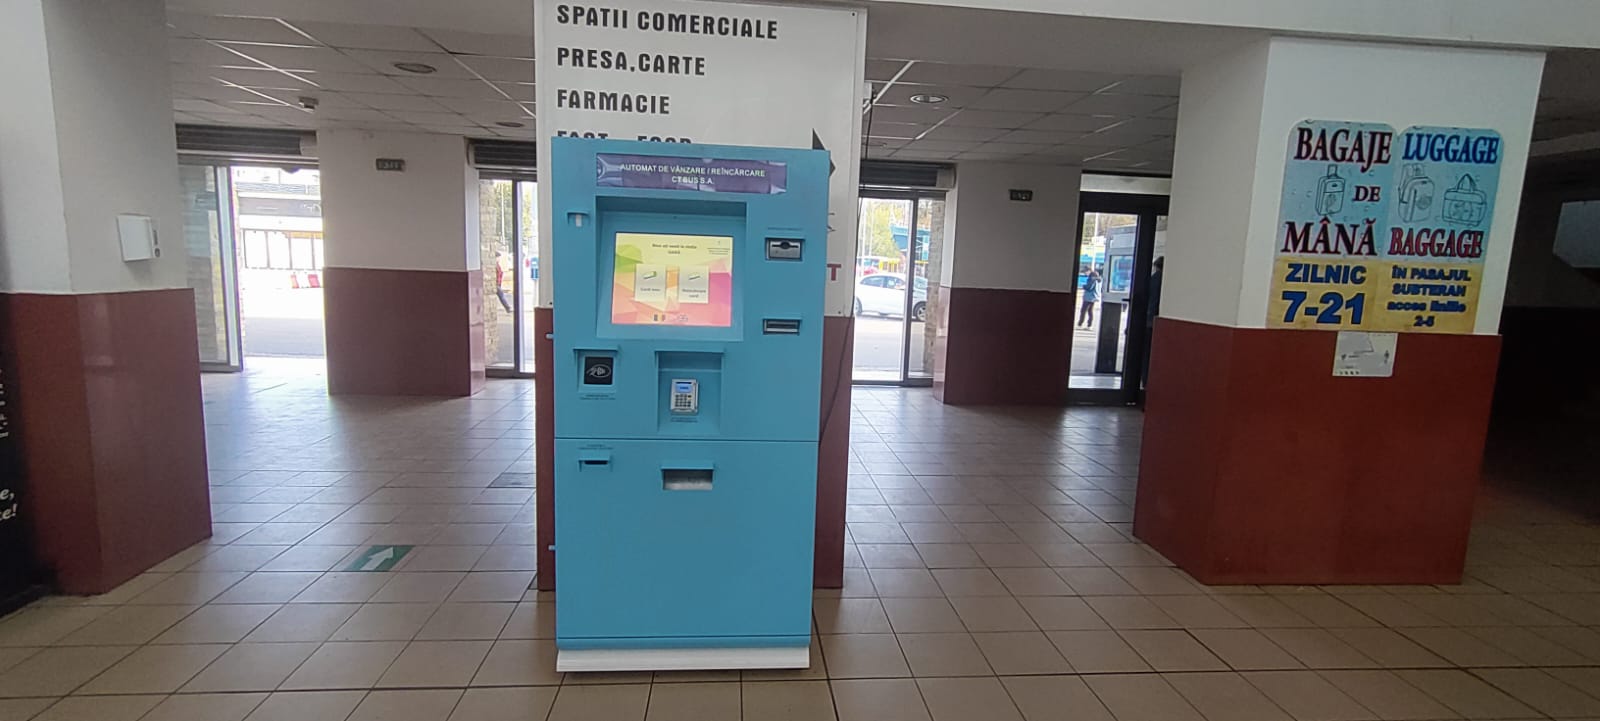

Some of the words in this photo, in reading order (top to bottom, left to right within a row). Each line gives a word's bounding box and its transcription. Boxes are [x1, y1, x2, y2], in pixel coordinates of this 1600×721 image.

[557, 5, 628, 29] SPATII
[637, 11, 778, 39] COMERCIALE
[557, 89, 670, 114] FARMACIE
[1294, 127, 1393, 173] BAGAJE
[1402, 133, 1499, 164] LUGGAGE
[620, 163, 657, 173] AUTOMAT
[658, 165, 669, 173] DE
[670, 165, 706, 175] VÂNZARE
[1352, 185, 1381, 202] DE
[1281, 217, 1378, 256] MÂNĂ
[1388, 227, 1484, 258] BAGGAGE
[1285, 263, 1367, 285] ZILNIC
[1410, 267, 1471, 281] PASAJUL
[1392, 283, 1467, 297] SUBTERAN
[1281, 291, 1365, 324] 7-21
